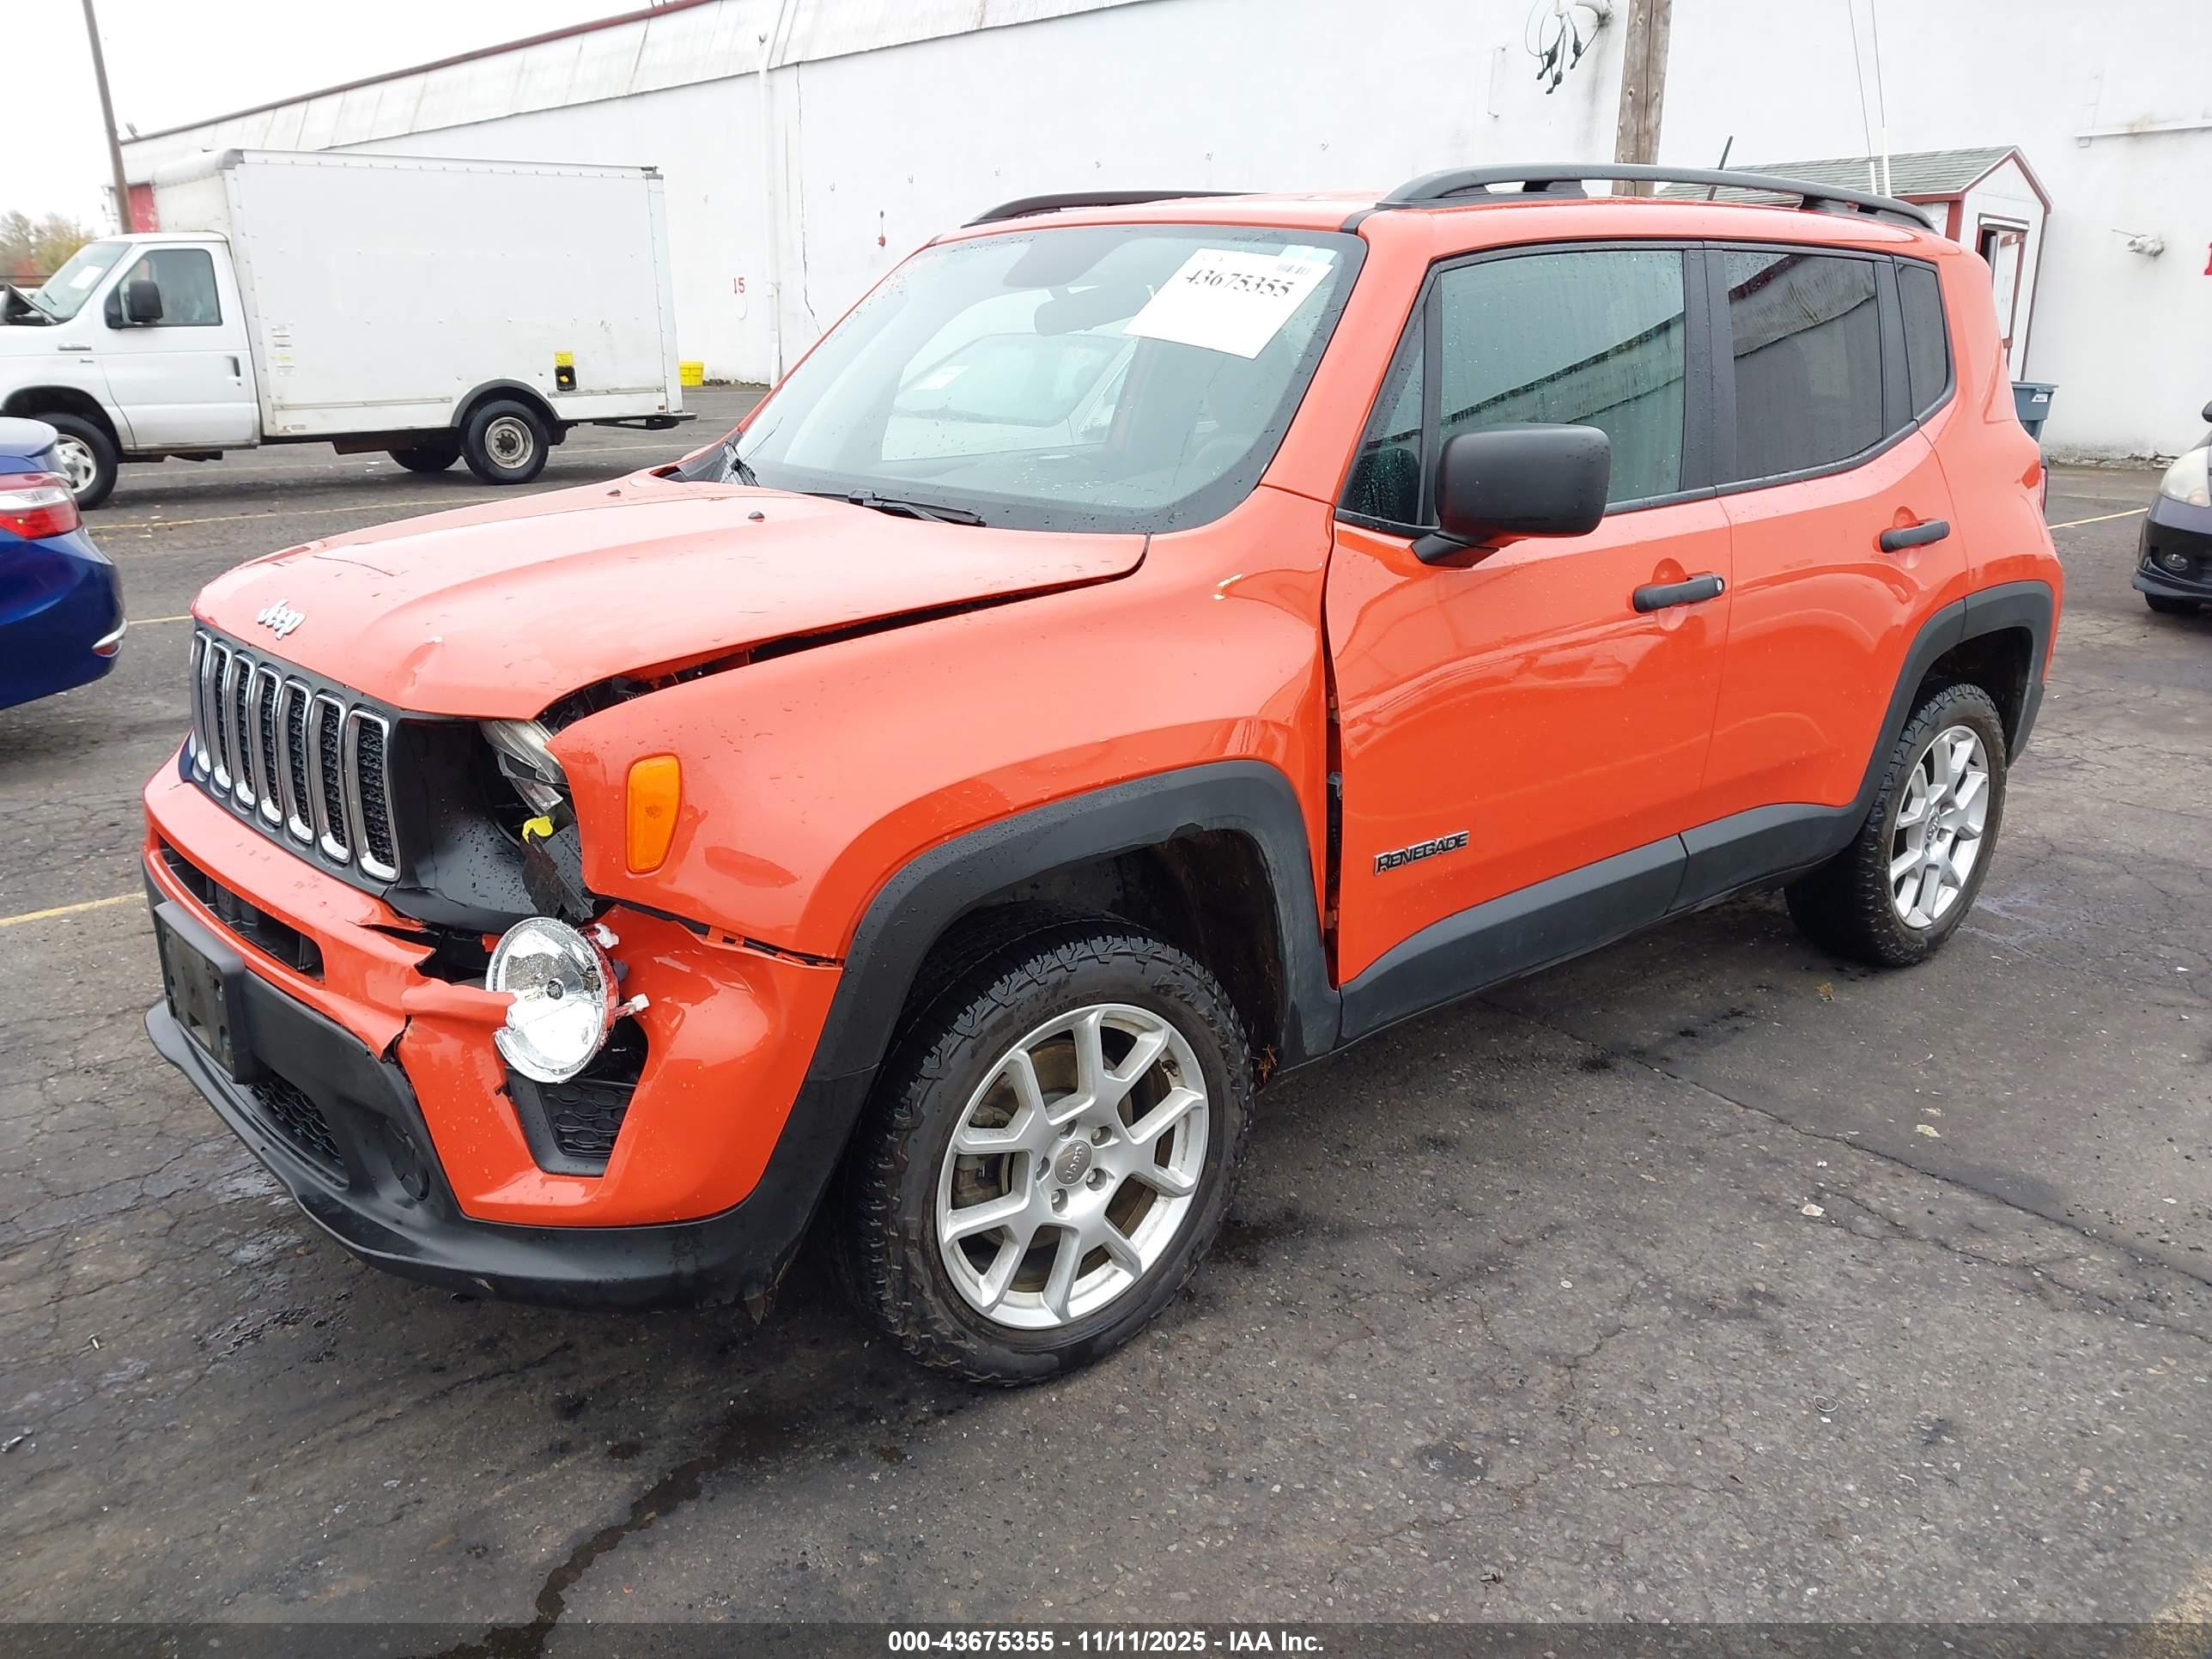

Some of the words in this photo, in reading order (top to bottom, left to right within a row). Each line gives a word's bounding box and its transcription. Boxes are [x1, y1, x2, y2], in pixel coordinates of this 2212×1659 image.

[733, 276, 745, 295] 15
[1185, 268, 1295, 298] 43675355
[257, 599, 307, 641] Jeep
[1374, 830, 1470, 876] RENEGADE
